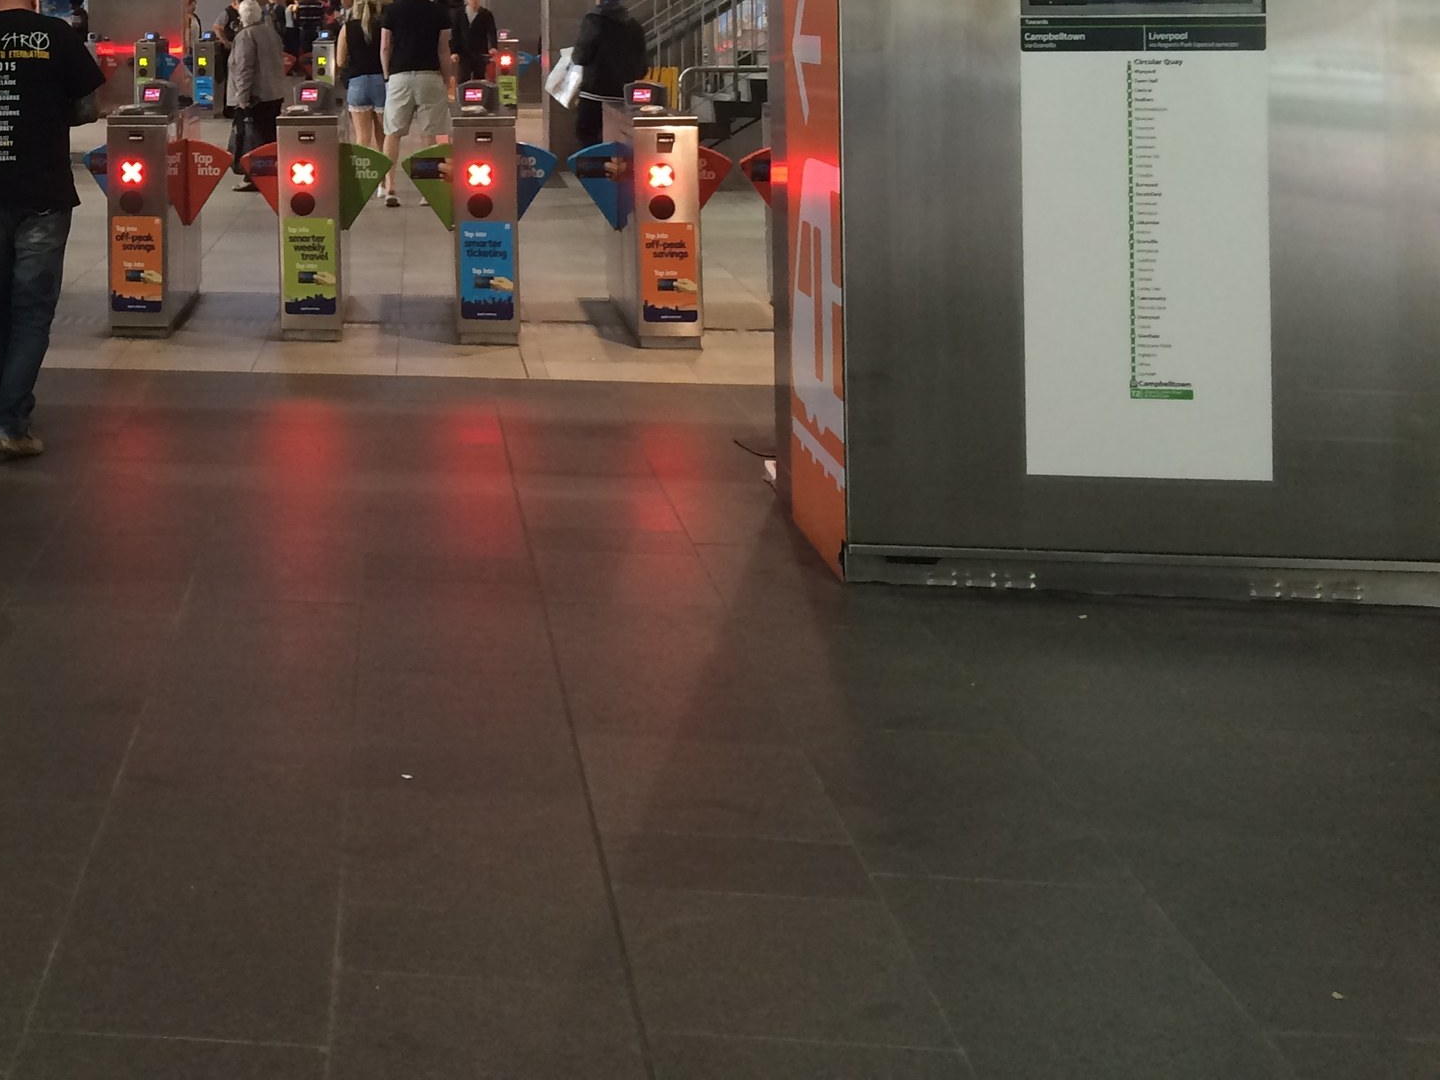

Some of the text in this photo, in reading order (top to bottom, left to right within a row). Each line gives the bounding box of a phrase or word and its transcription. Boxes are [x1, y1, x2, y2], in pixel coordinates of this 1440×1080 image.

[1024, 32, 1086, 42] Campbelltown
[1149, 32, 1188, 41] Liverpool
[192, 152, 213, 166] Tap
[350, 155, 370, 169] Tap
[197, 164, 220, 175] into
[355, 167, 378, 179] into
[116, 232, 153, 243] off-peak
[122, 243, 155, 252] savings
[294, 243, 325, 253] weekly
[646, 240, 686, 250] off-peak
[301, 252, 328, 260] travel
[467, 249, 507, 260] ticketing
[653, 250, 688, 260] savings
